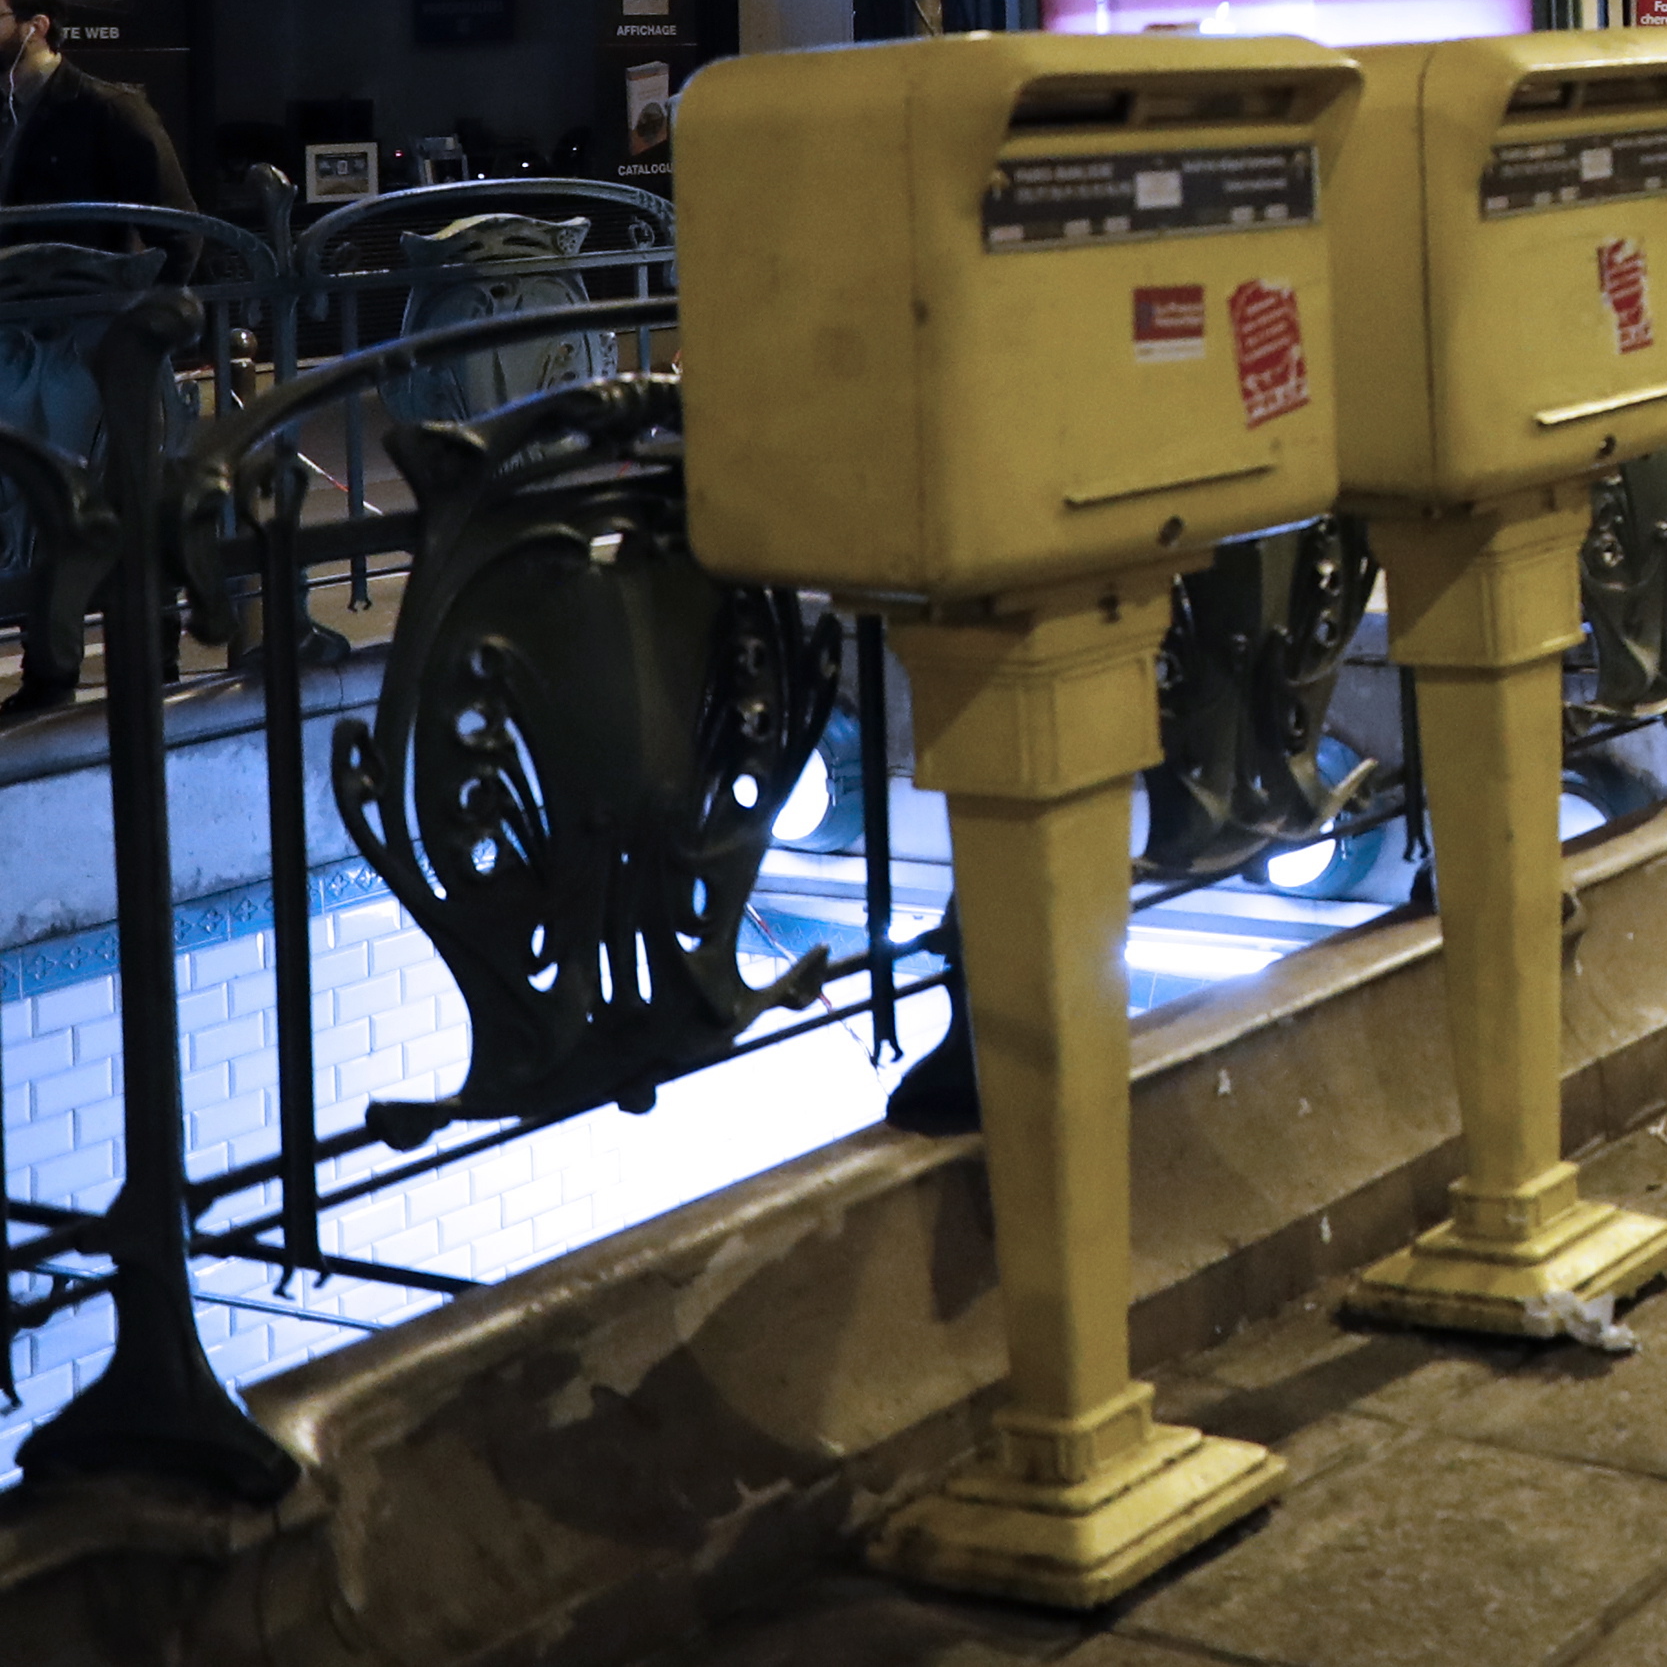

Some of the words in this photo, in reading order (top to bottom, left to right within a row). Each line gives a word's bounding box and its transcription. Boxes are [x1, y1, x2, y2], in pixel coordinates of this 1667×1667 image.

[62, 26, 81, 39] TE
[84, 26, 120, 40] WEB
[616, 25, 677, 36] AFFICHAGE
[617, 163, 672, 177] CATALOGU
